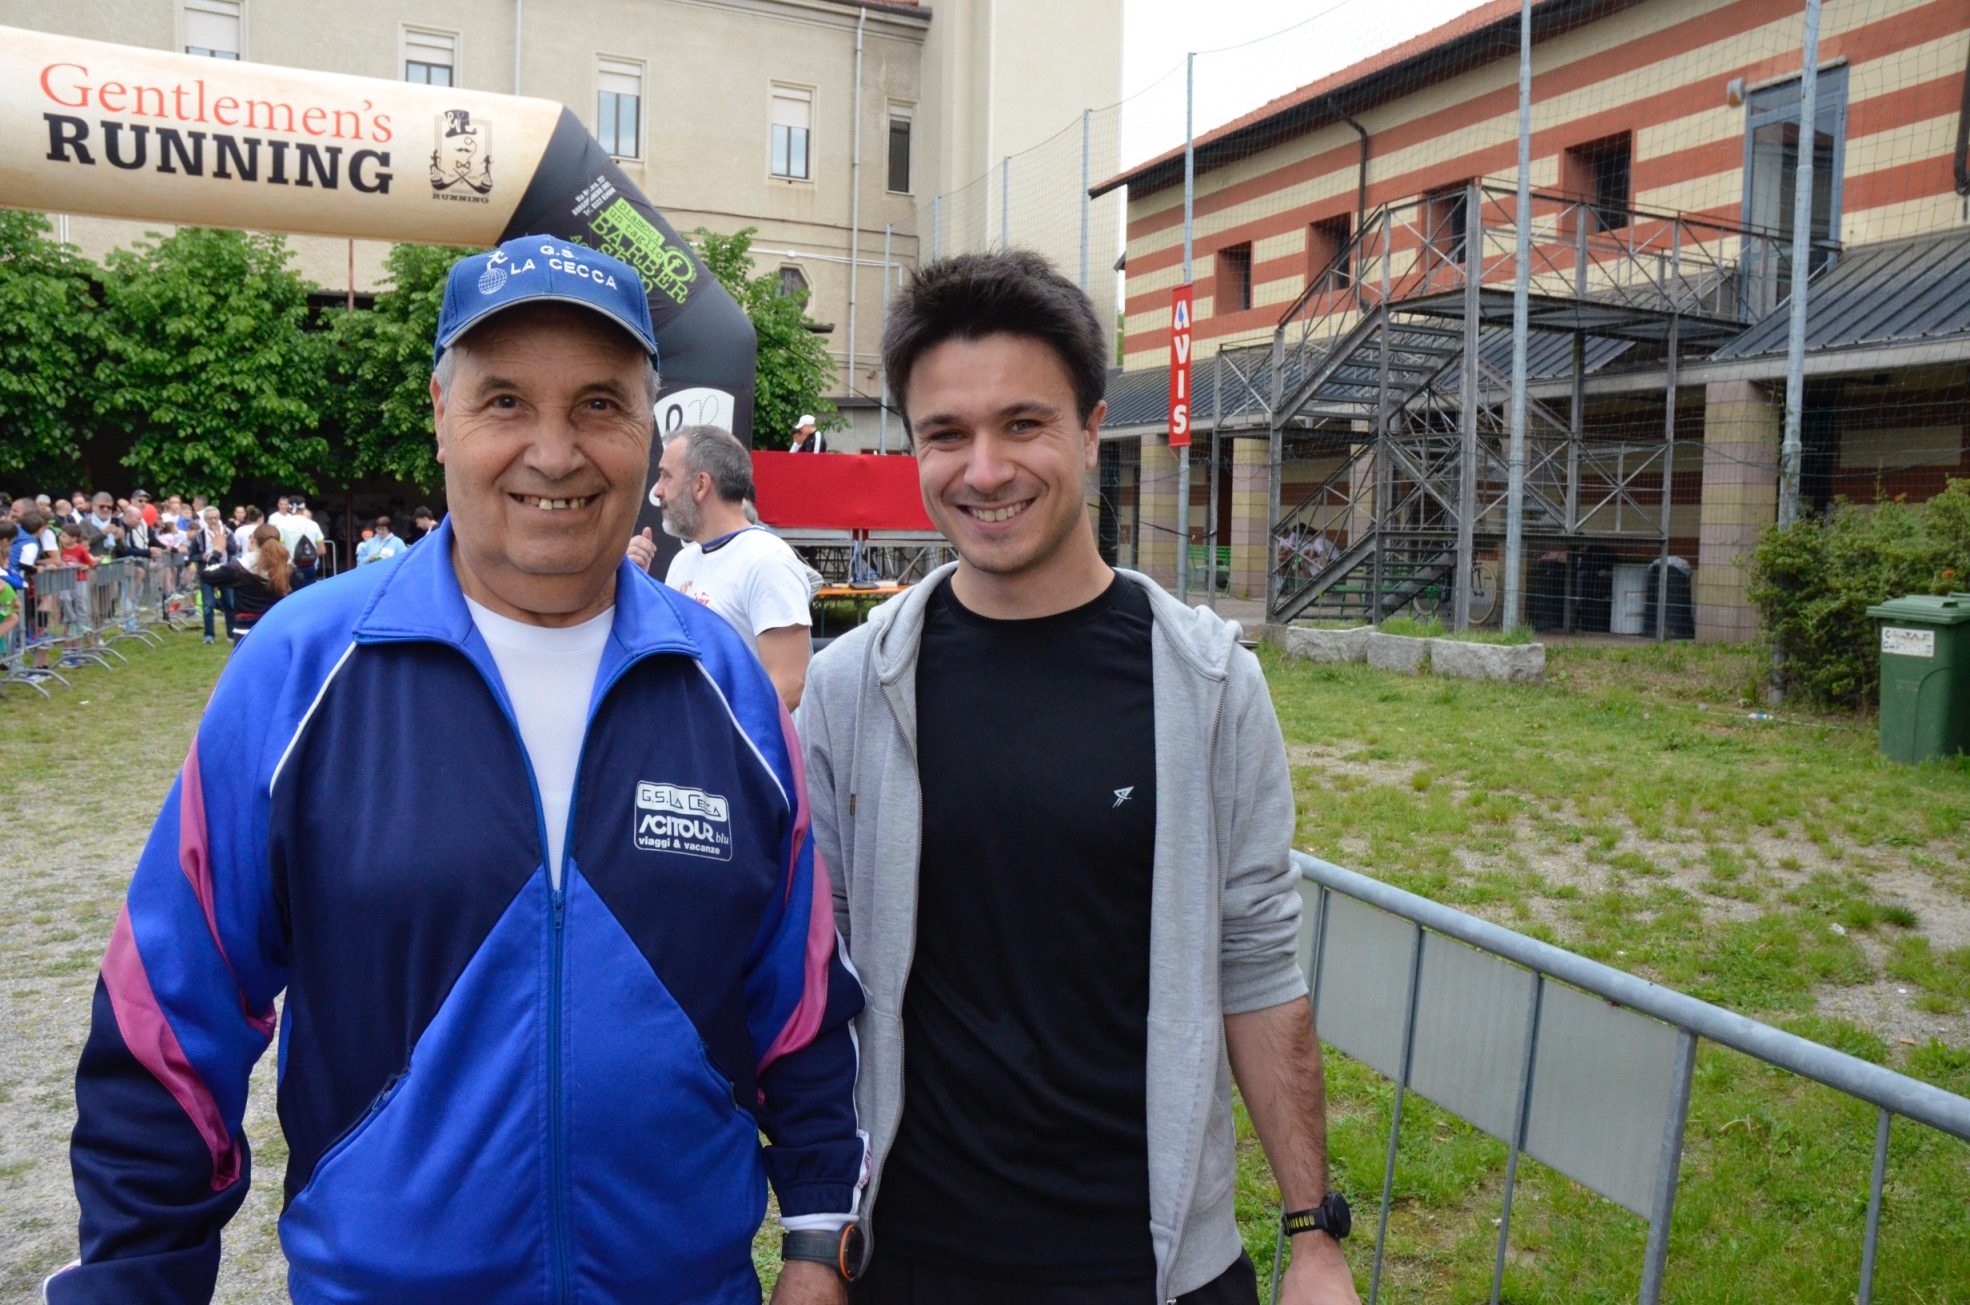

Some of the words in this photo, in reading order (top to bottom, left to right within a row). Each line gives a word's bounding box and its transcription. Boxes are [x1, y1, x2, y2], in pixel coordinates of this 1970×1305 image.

[39, 63, 393, 143] Gentlemen's
[43, 112, 394, 195] RUNNING
[432, 193, 489, 204] RUNNING
[609, 210, 623, 224] un
[624, 223, 664, 261] taglio
[619, 202, 662, 243] Diamoci
[510, 258, 536, 276] LA
[549, 258, 618, 290] CECCA
[588, 210, 689, 304] BARBER
[1173, 300, 1190, 434] AVIS
[638, 814, 715, 843] ACITOUR
[638, 836, 671, 849] viaggi
[673, 840, 681, 849] &
[684, 842, 721, 855] vacanze
